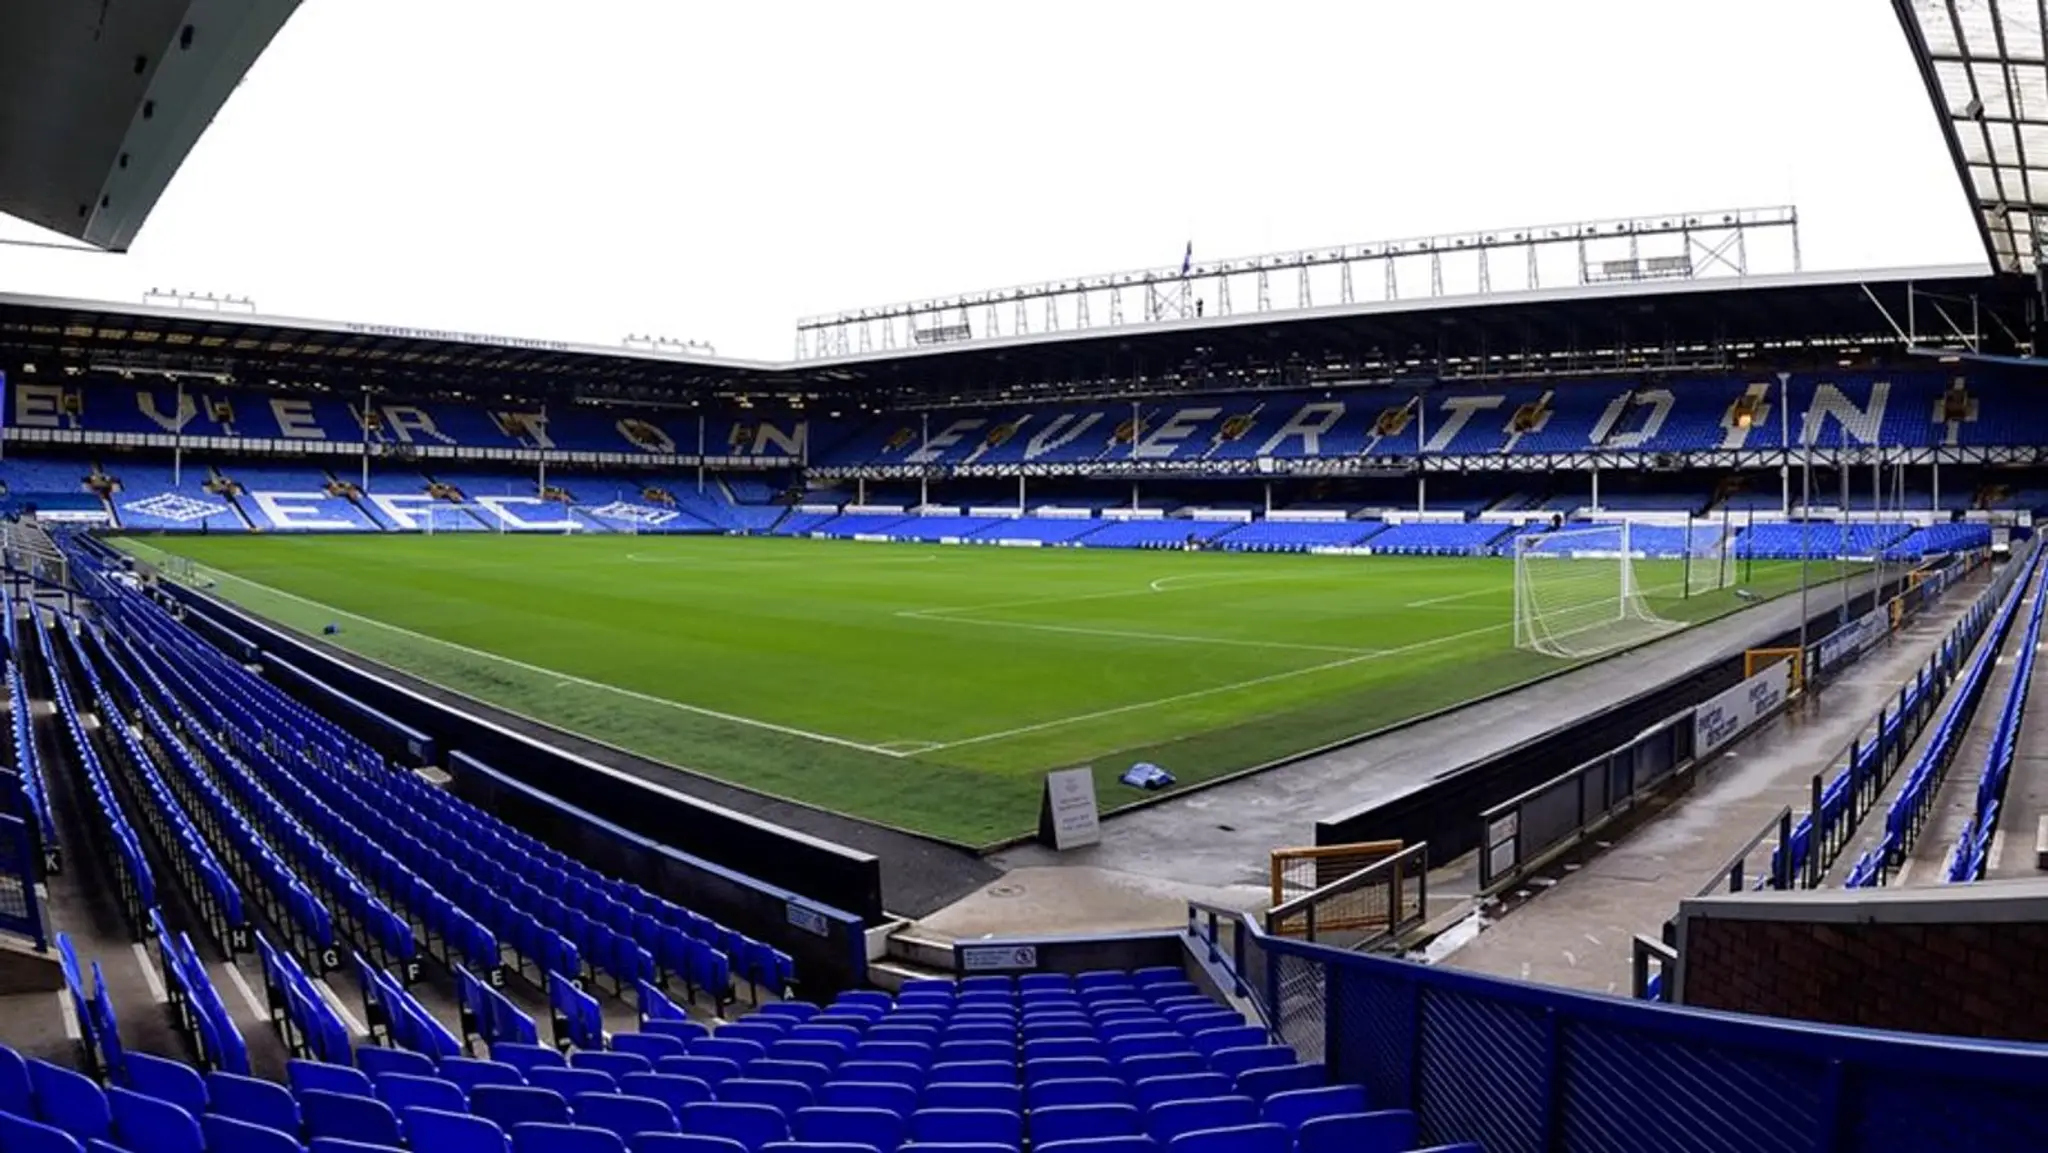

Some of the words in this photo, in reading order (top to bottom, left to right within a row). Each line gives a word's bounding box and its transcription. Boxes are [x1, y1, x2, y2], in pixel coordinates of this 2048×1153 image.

[252, 491, 583, 529] EFC
[45, 854, 58, 871] K
[232, 930, 246, 947] H
[323, 951, 338, 967] G
[408, 964, 420, 981] F
[491, 971, 503, 986] E
[784, 985, 795, 999] A
